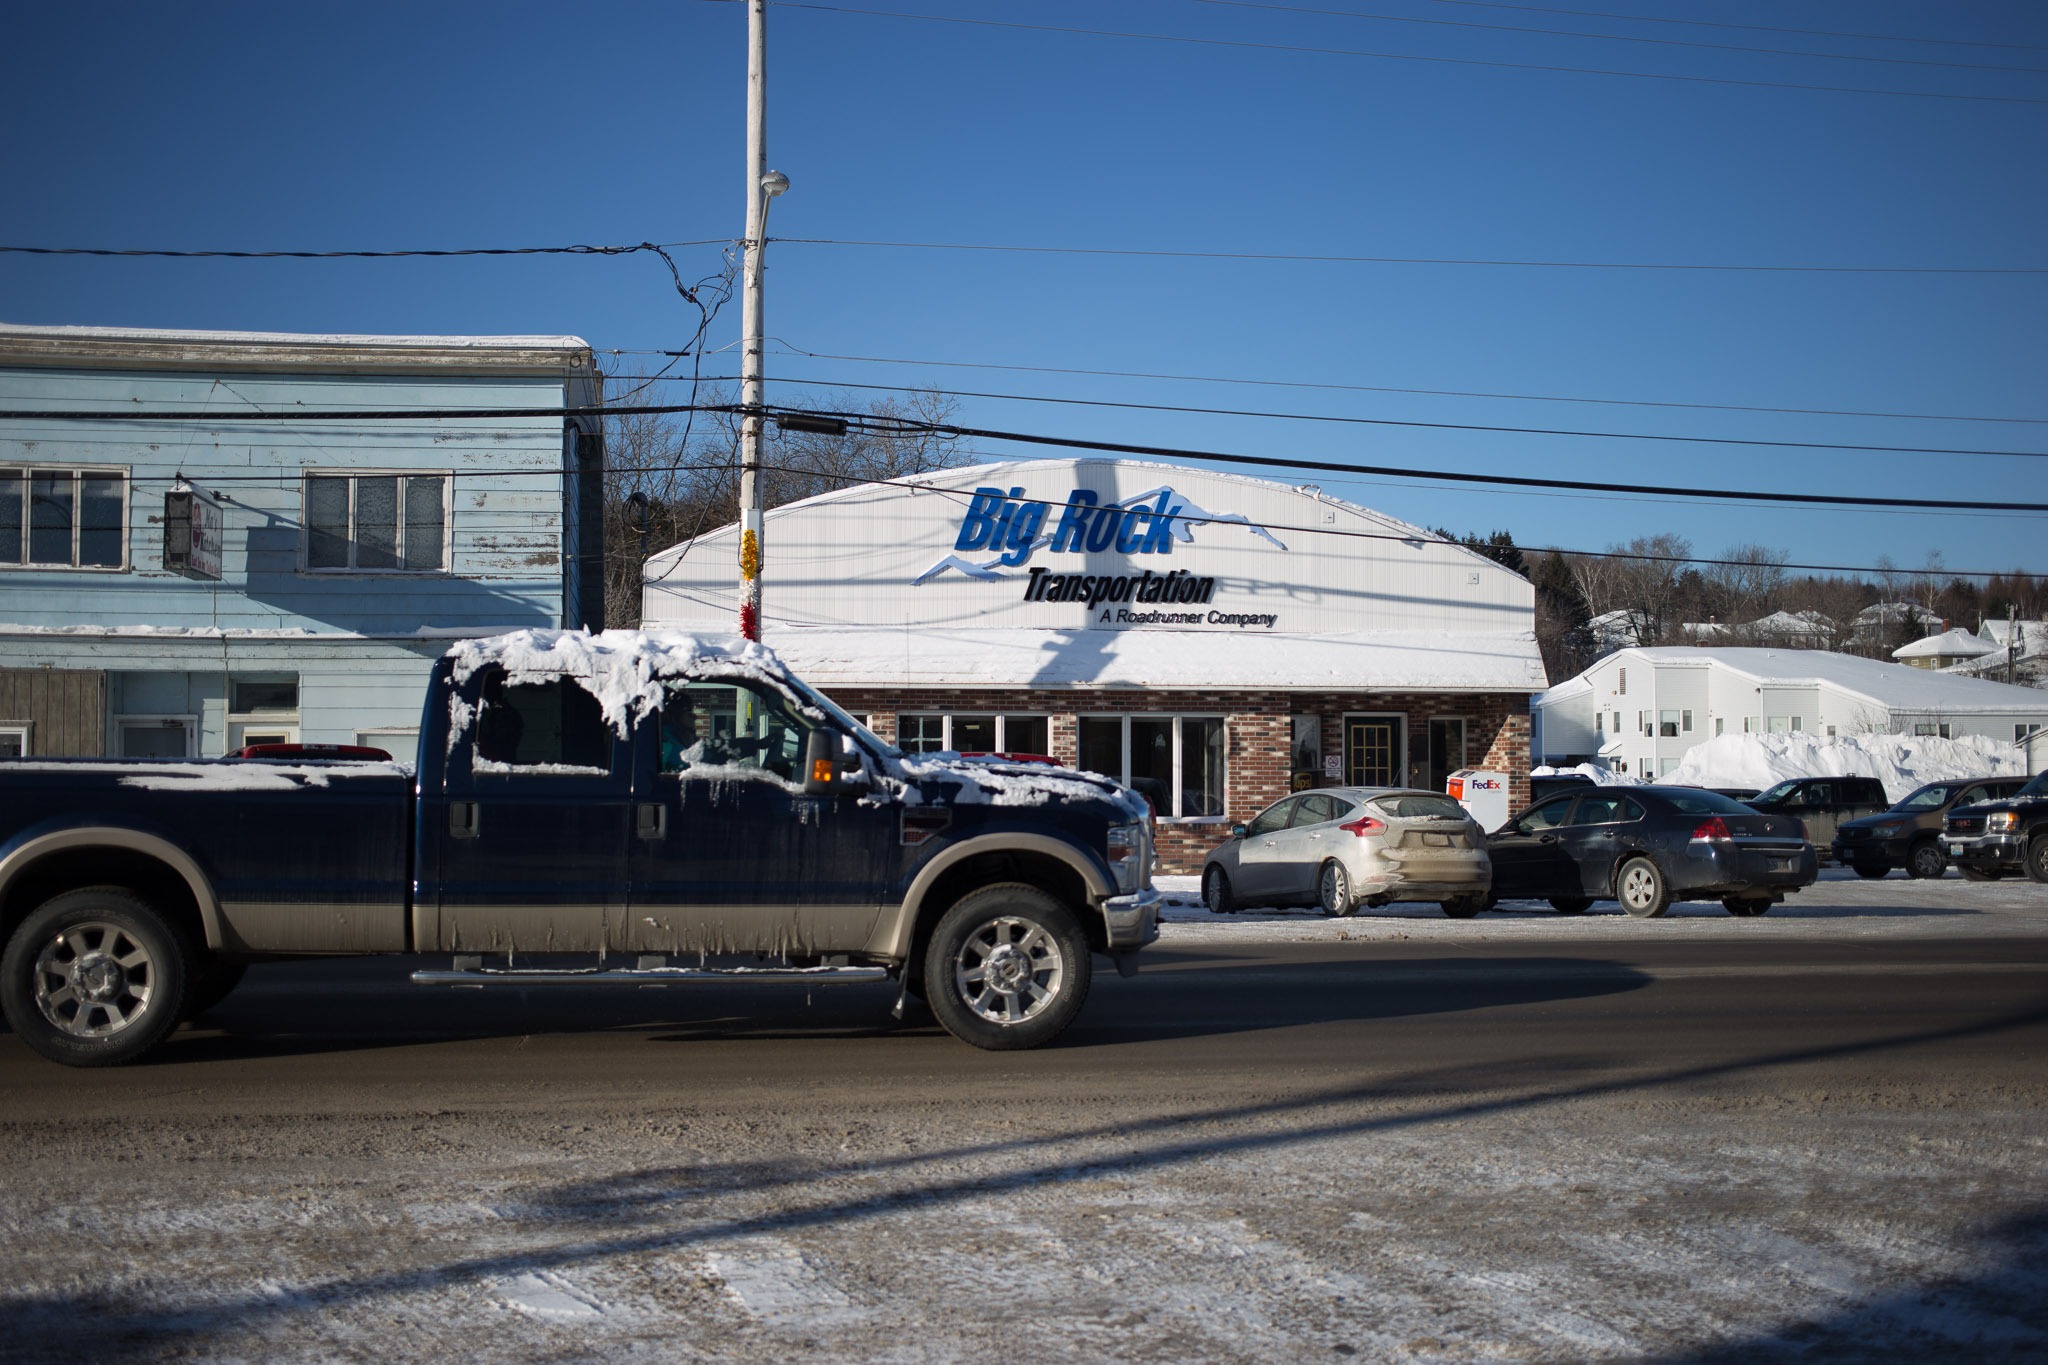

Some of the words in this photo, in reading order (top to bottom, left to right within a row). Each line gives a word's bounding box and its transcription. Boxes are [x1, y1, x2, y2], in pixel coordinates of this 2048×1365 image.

[954, 487, 1049, 567] Big
[1050, 489, 1184, 554] Rock
[1023, 567, 1215, 610] Transportation
[1100, 611, 1112, 623] A
[1116, 609, 1205, 625] Roadrunner
[1207, 610, 1278, 628] Company
[1472, 779, 1501, 790] FedEx
